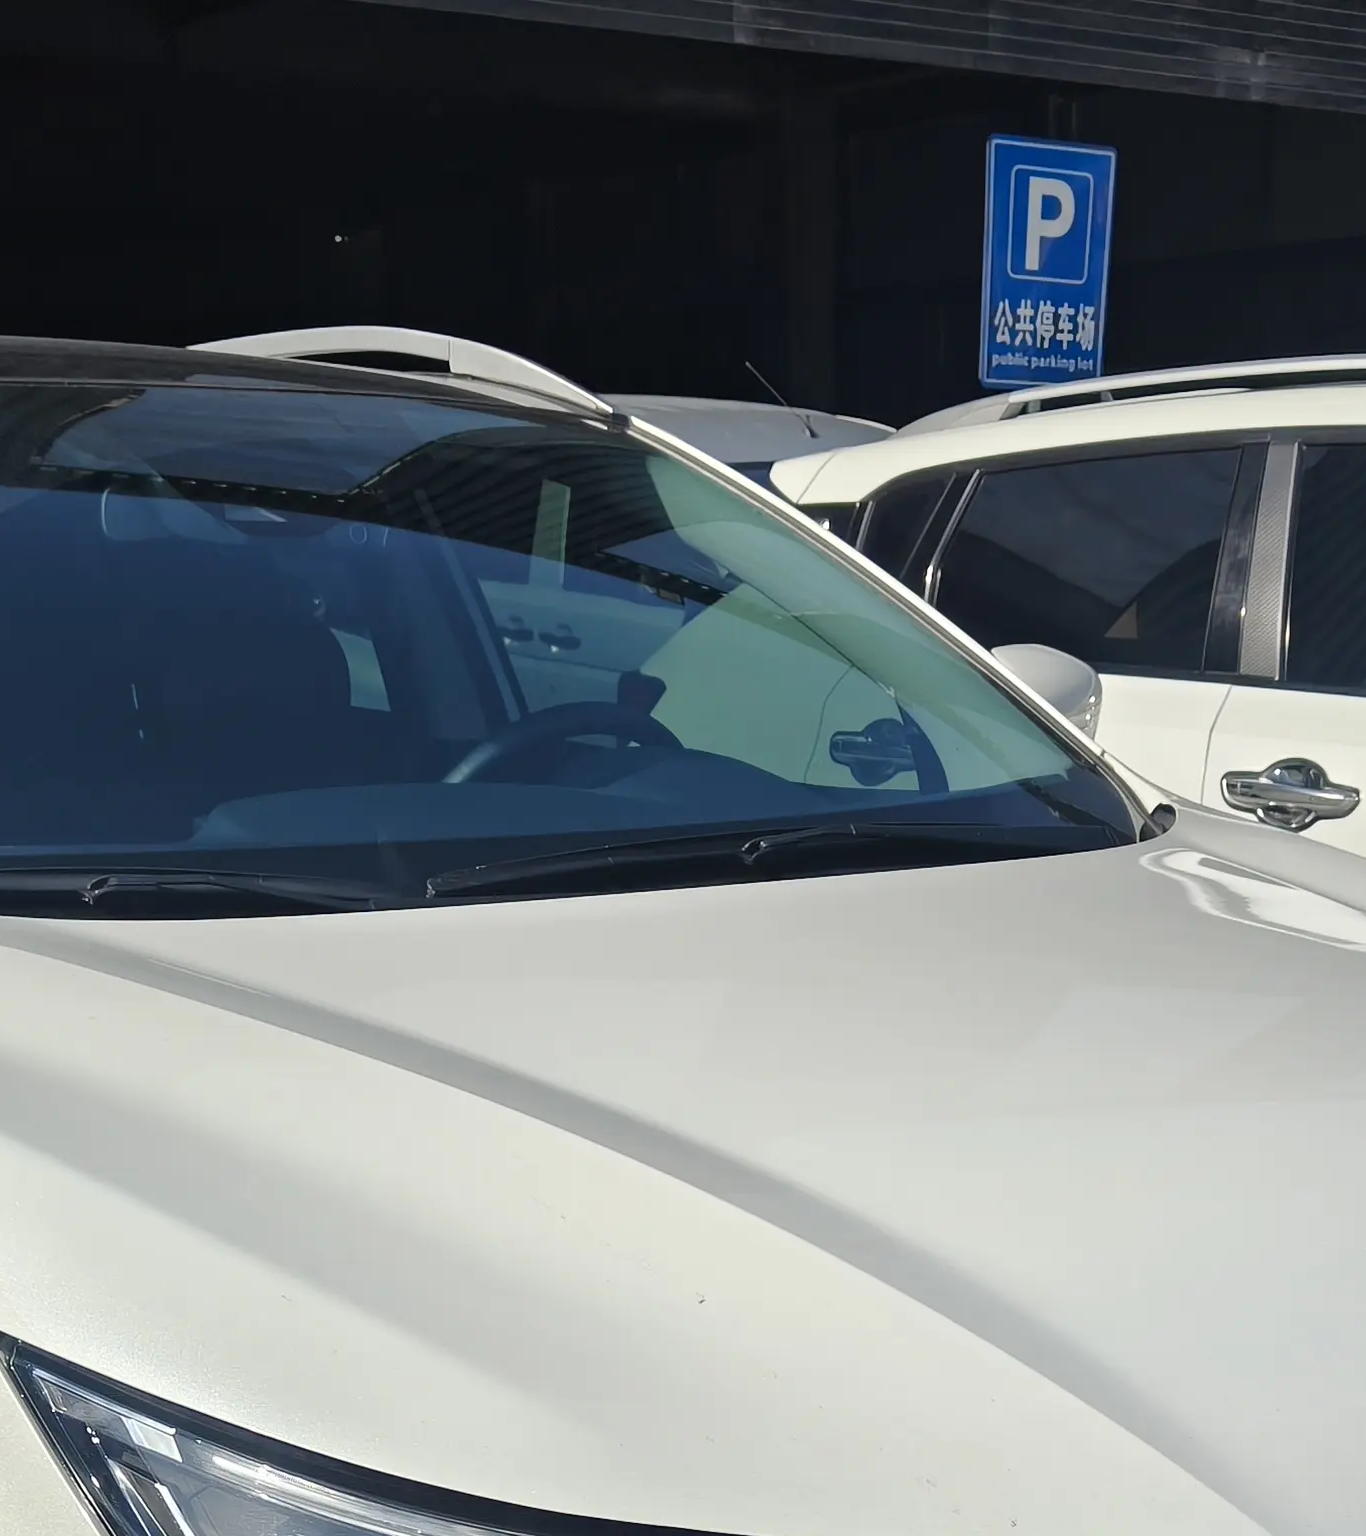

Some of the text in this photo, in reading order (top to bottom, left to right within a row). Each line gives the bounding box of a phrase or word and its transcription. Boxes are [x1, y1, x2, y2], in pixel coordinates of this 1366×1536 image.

[1025, 176, 1075, 271] P
[994, 298, 1095, 351] 公共停车场
[991, 352, 1094, 373] public parking lot
